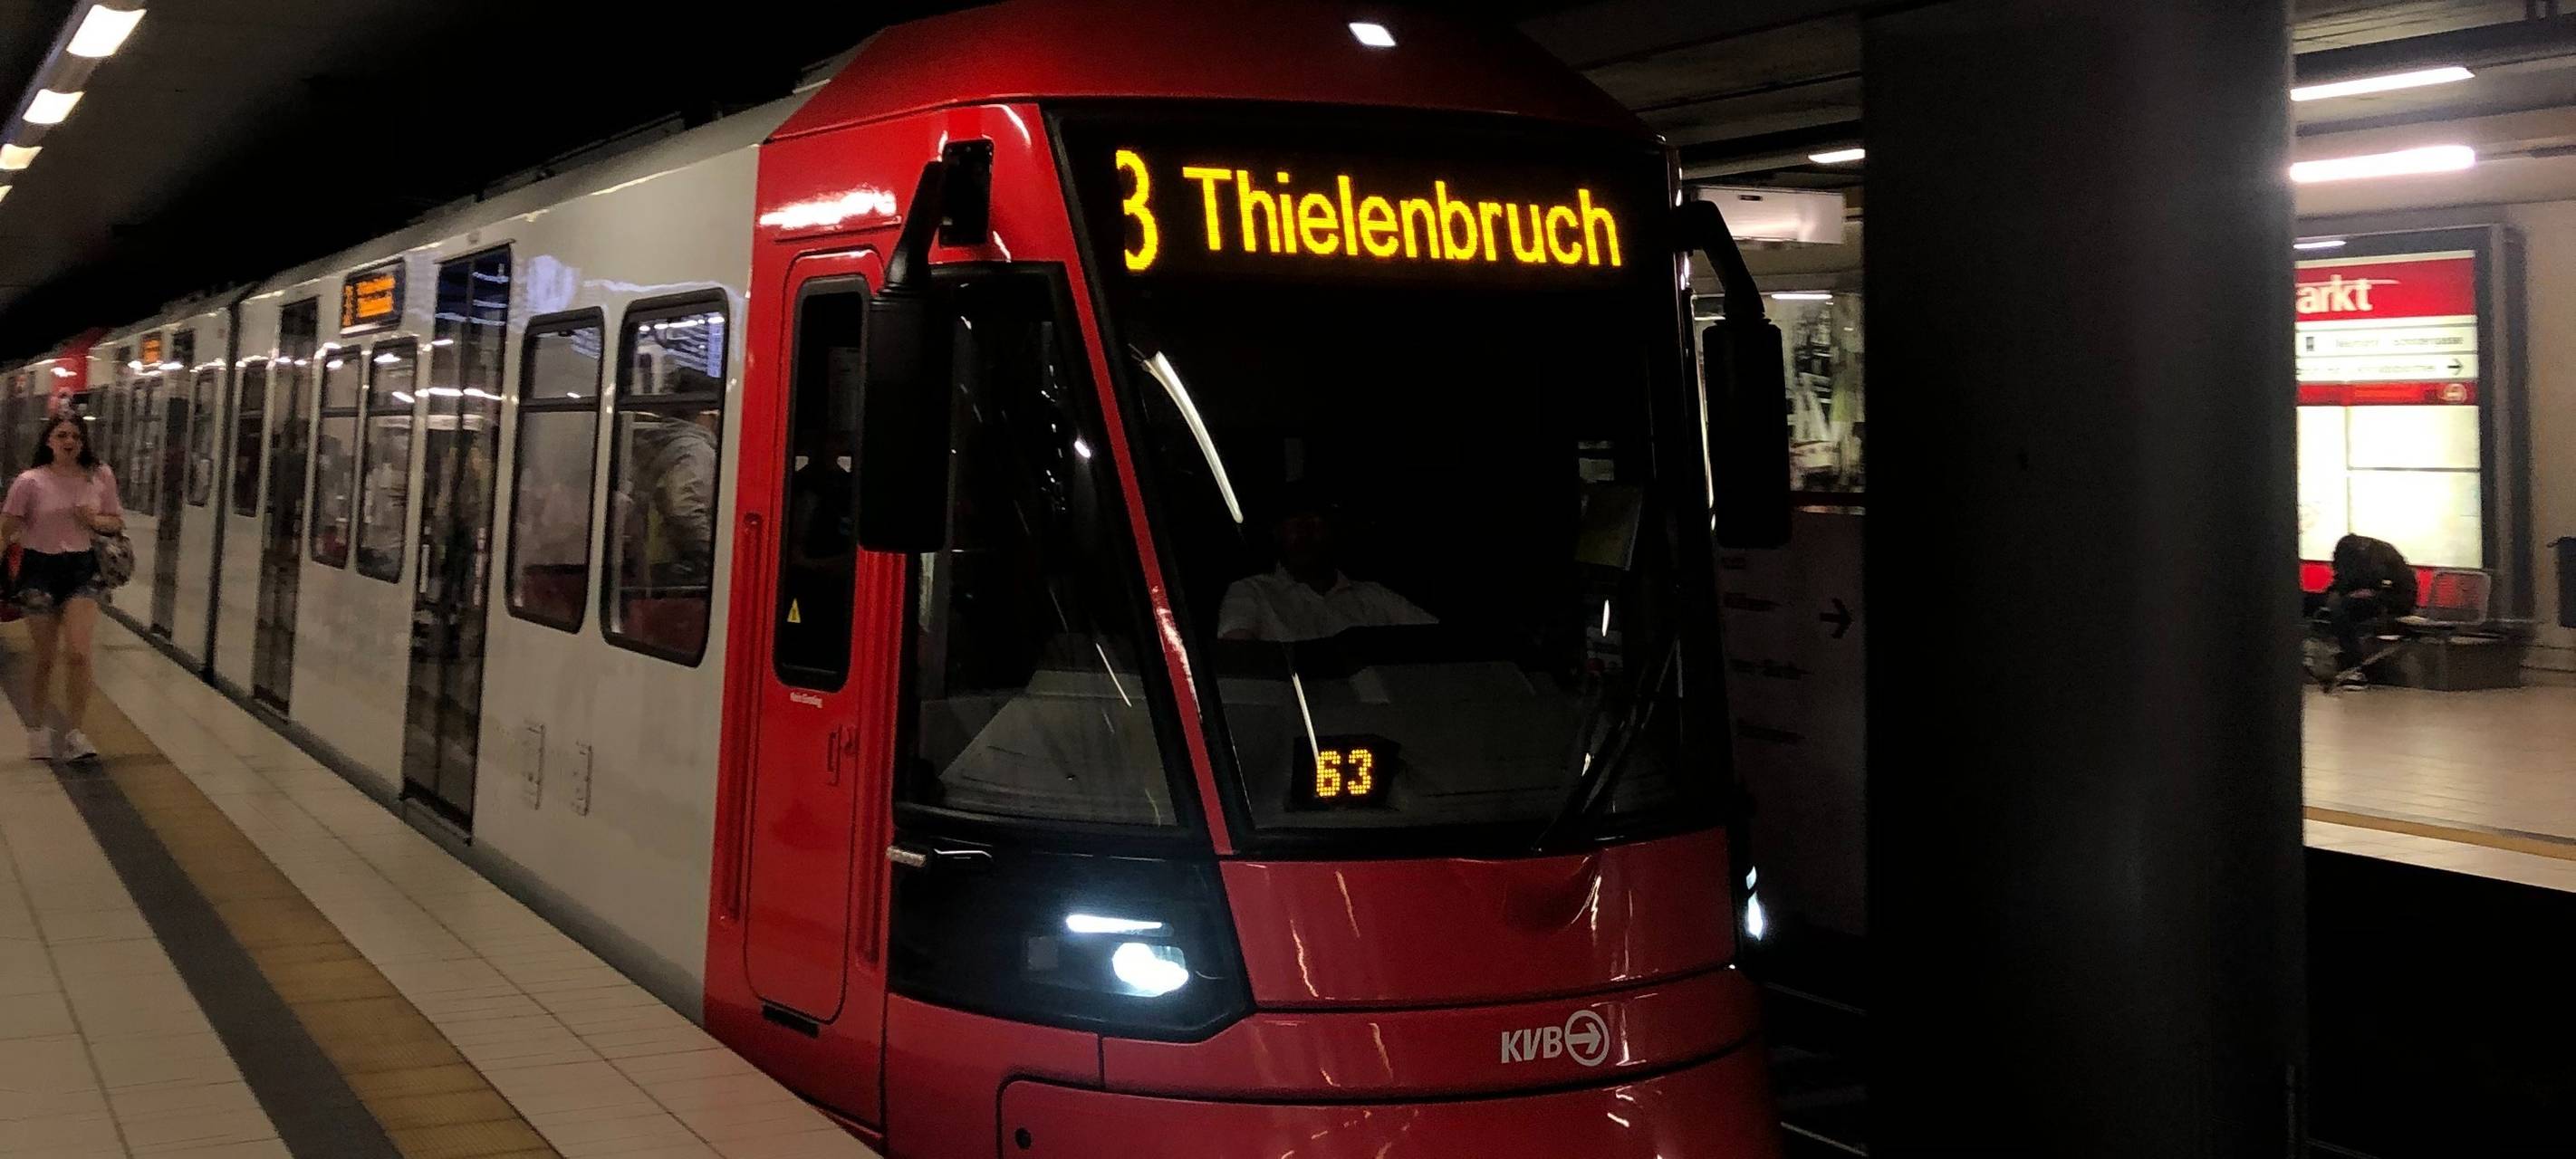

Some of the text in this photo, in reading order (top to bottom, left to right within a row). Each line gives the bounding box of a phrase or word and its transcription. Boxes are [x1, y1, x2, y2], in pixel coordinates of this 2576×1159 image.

[1115, 148, 1622, 273] 3 Thielenbruch
[1316, 749, 1372, 798] 63
[1501, 1025, 1563, 1064] KVB
